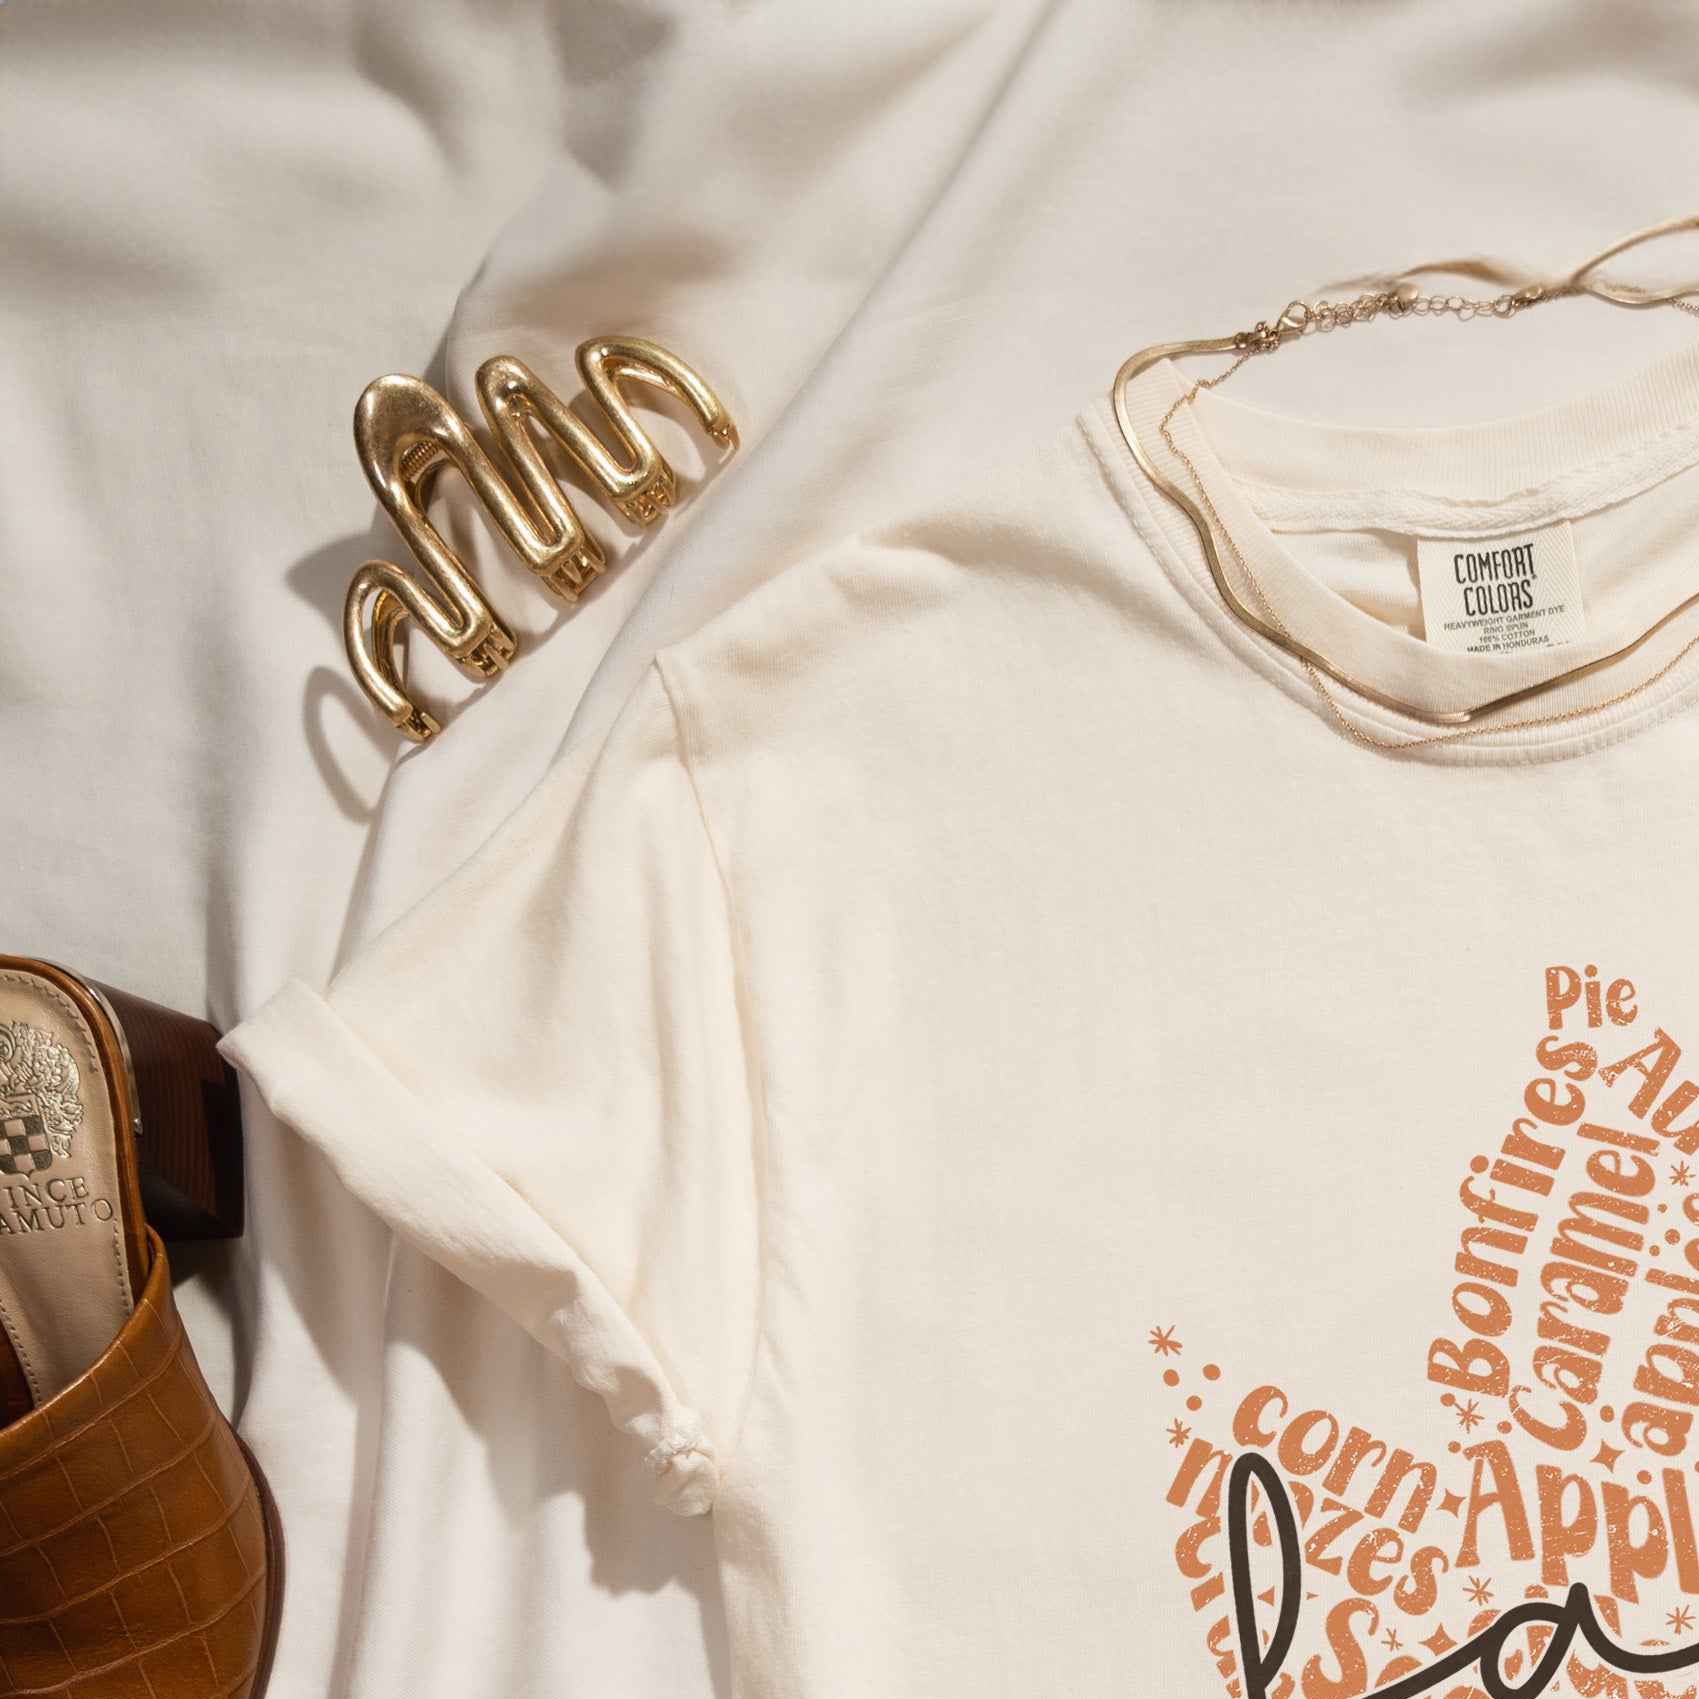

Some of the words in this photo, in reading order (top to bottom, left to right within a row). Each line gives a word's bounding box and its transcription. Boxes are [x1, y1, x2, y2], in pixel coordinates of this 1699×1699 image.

[1454, 543, 1535, 584] COMFORT
[1463, 579, 1534, 617] COLORS
[1443, 616, 1504, 631] HEAVYWEIGHT
[1506, 609, 1547, 624] GARMENT
[1548, 605, 1566, 616] DYE
[1483, 626, 1505, 635] RING
[1506, 621, 1529, 632] SPUN
[1501, 629, 1536, 642] COTTON
[1492, 643, 1502, 651] IN
[1503, 634, 1550, 650] HONDURAS
[1545, 963, 1639, 1030] Pie
[1427, 1035, 1599, 1398] Bonfires
[1508, 1122, 1661, 1452] Caramel
[1232, 1384, 1438, 1534] corn
